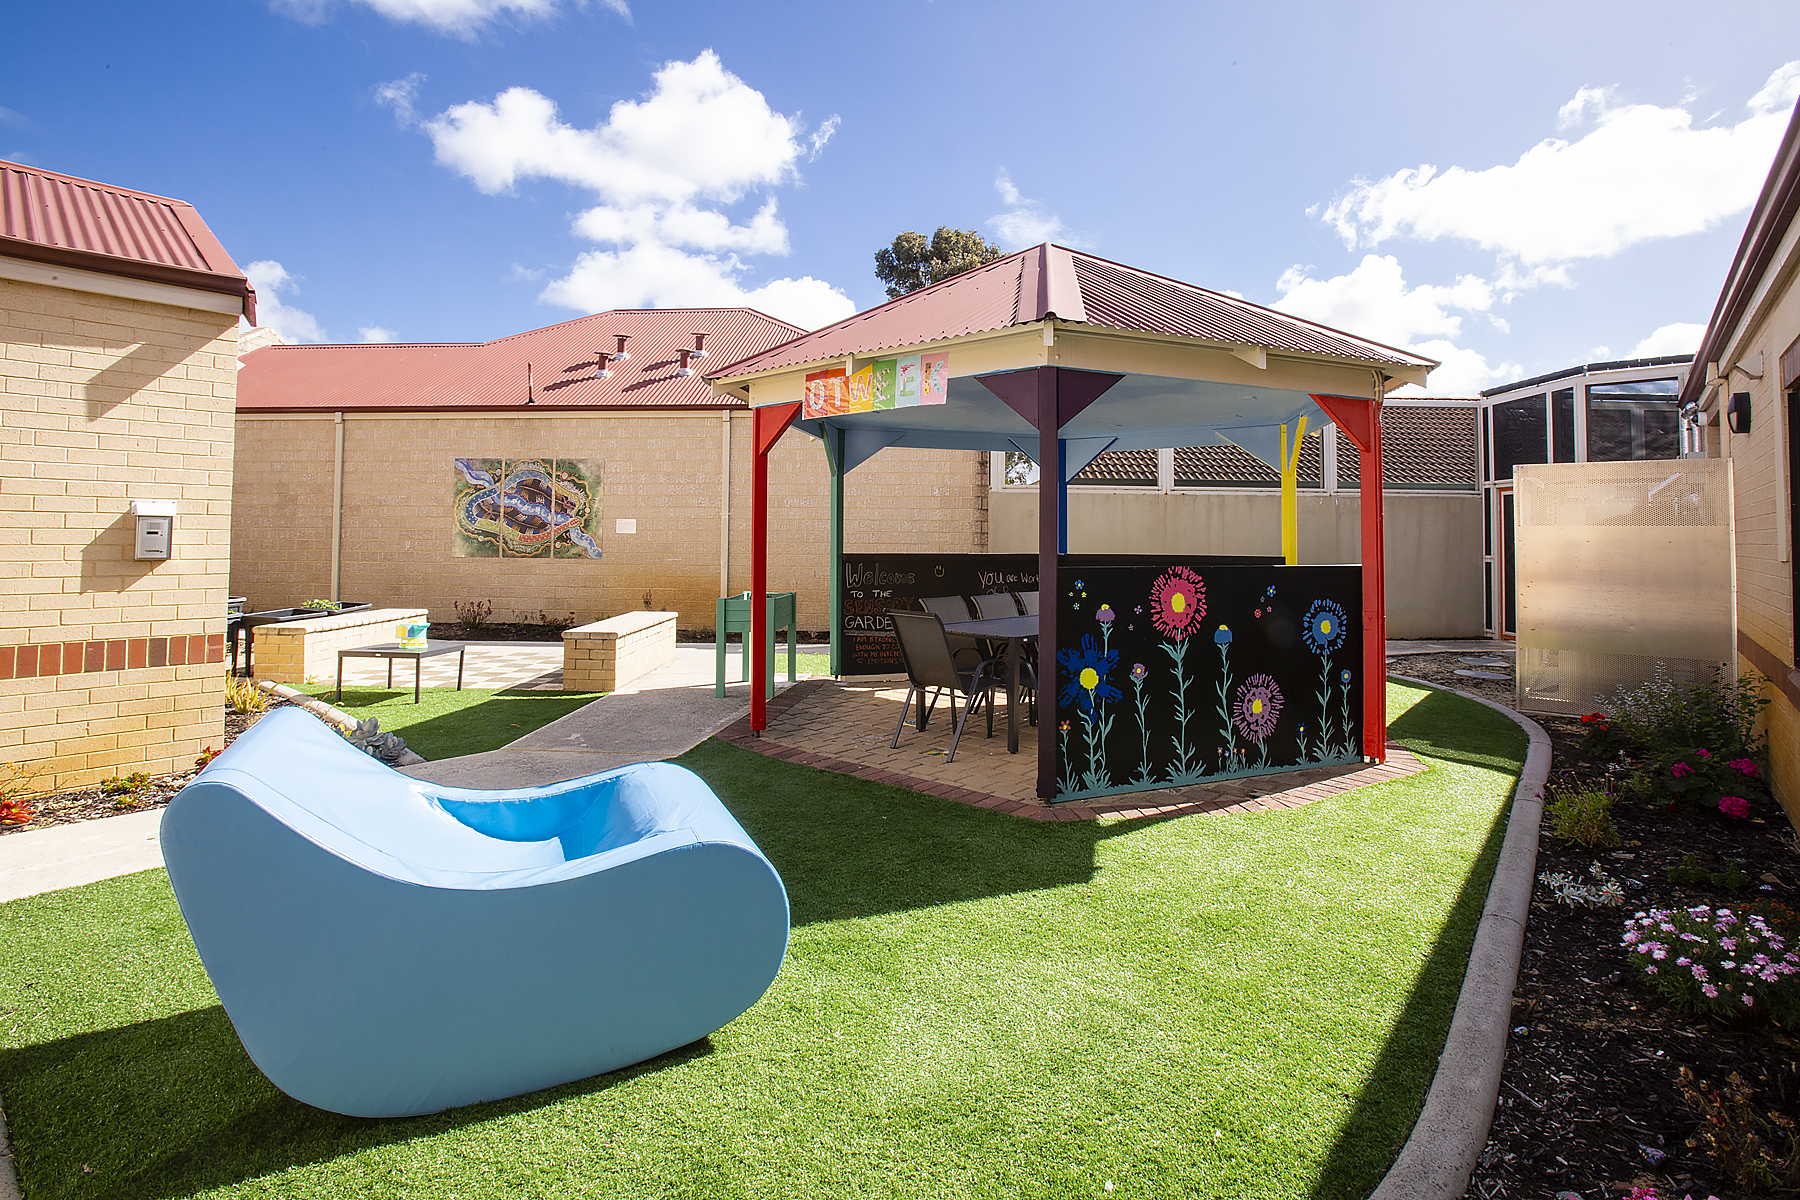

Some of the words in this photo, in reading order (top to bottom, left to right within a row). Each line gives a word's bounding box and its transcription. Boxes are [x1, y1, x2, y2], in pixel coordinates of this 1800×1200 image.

[845, 562, 916, 588] Welcome
[850, 590, 864, 598] TO
[871, 589, 893, 597] THE
[843, 596, 915, 615] SENSORY
[844, 615, 893, 630] GARDE
